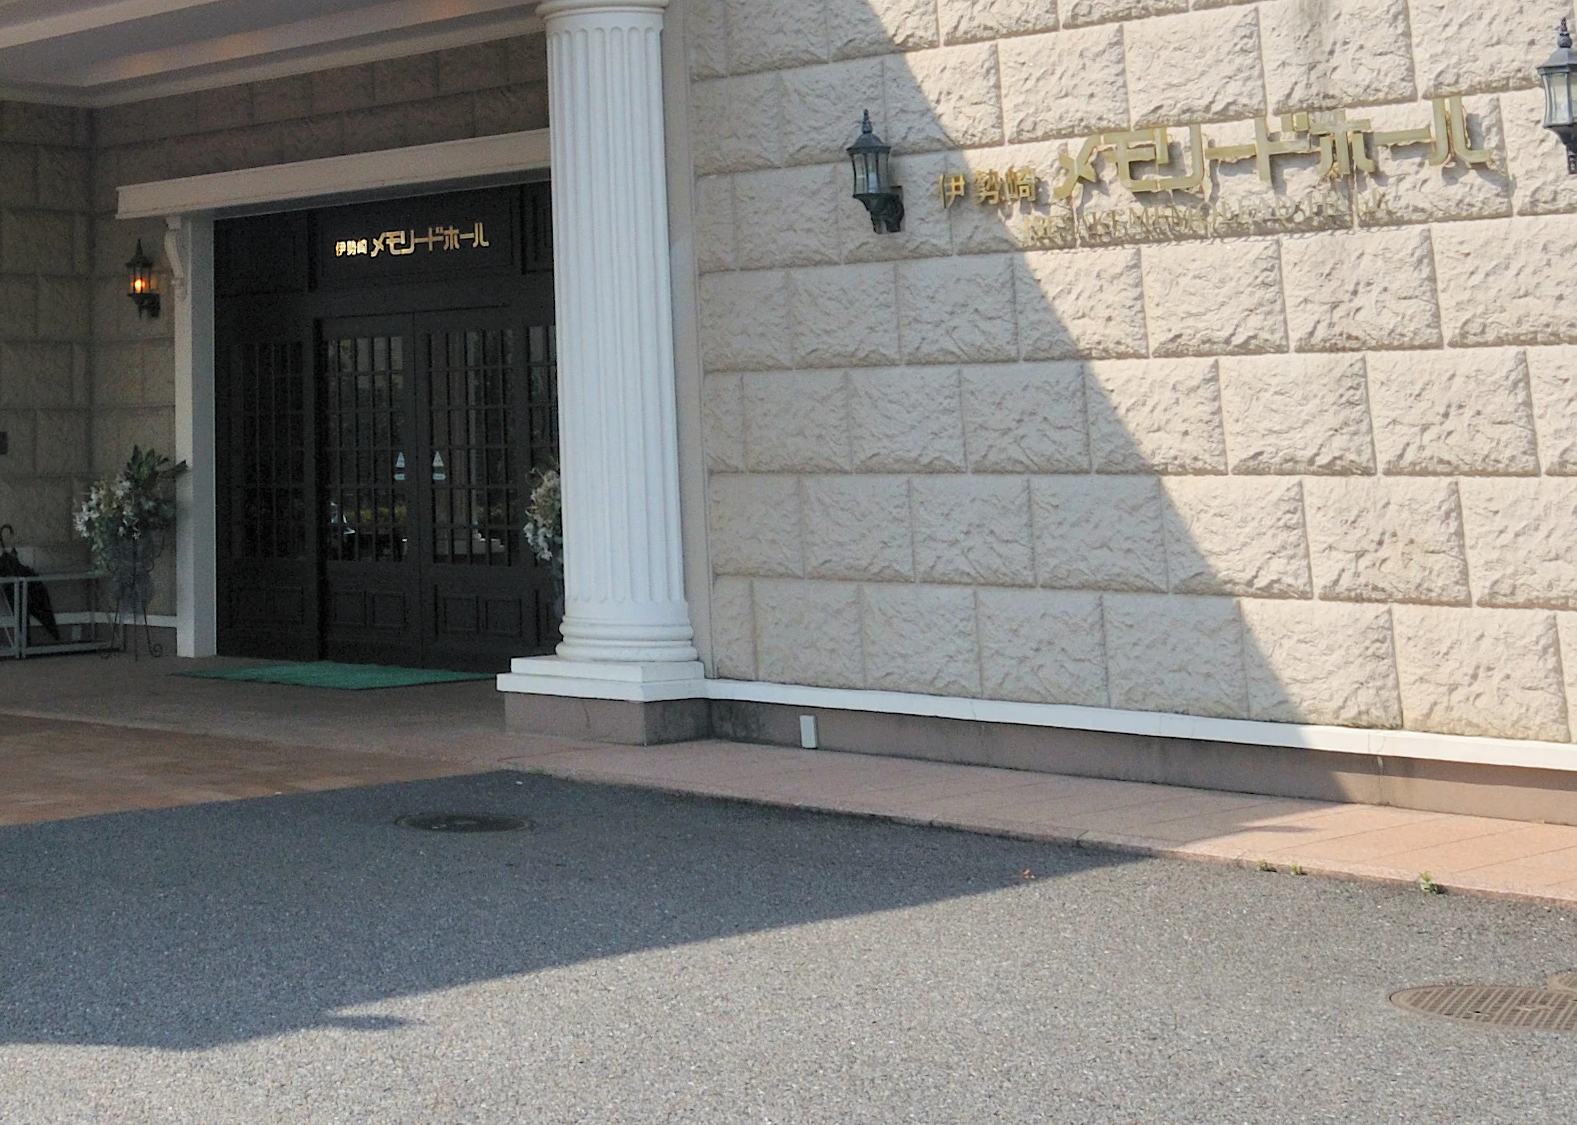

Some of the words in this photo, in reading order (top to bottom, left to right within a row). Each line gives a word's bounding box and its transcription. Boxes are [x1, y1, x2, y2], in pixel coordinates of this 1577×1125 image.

[938, 166, 1036, 208] 伊勢崎
[1053, 96, 1489, 198] メモリードホール
[370, 222, 489, 257] メモリードホール
